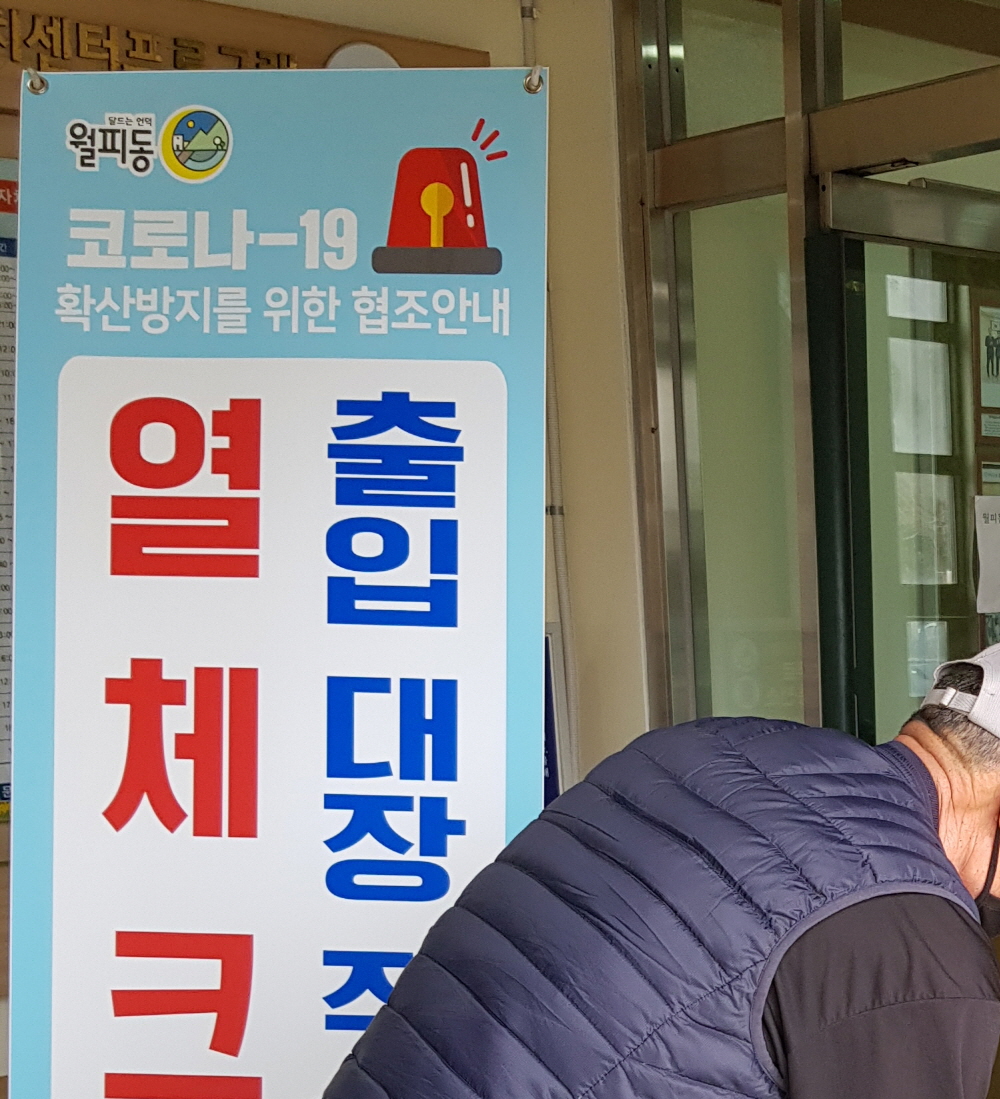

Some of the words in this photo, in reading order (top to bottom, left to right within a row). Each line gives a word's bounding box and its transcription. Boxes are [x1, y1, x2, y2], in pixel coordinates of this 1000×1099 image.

[69, 122, 154, 173] 월피동
[107, 116, 133, 126] 달드는
[136, 116, 153, 126] 언덕
[66, 207, 358, 271] 코로나-19
[55, 283, 252, 334] 확산방지를
[263, 285, 341, 335] 위한
[352, 285, 510, 337] 협조안내
[325, 391, 464, 628] 출입
[322, 675, 467, 902] 대장
